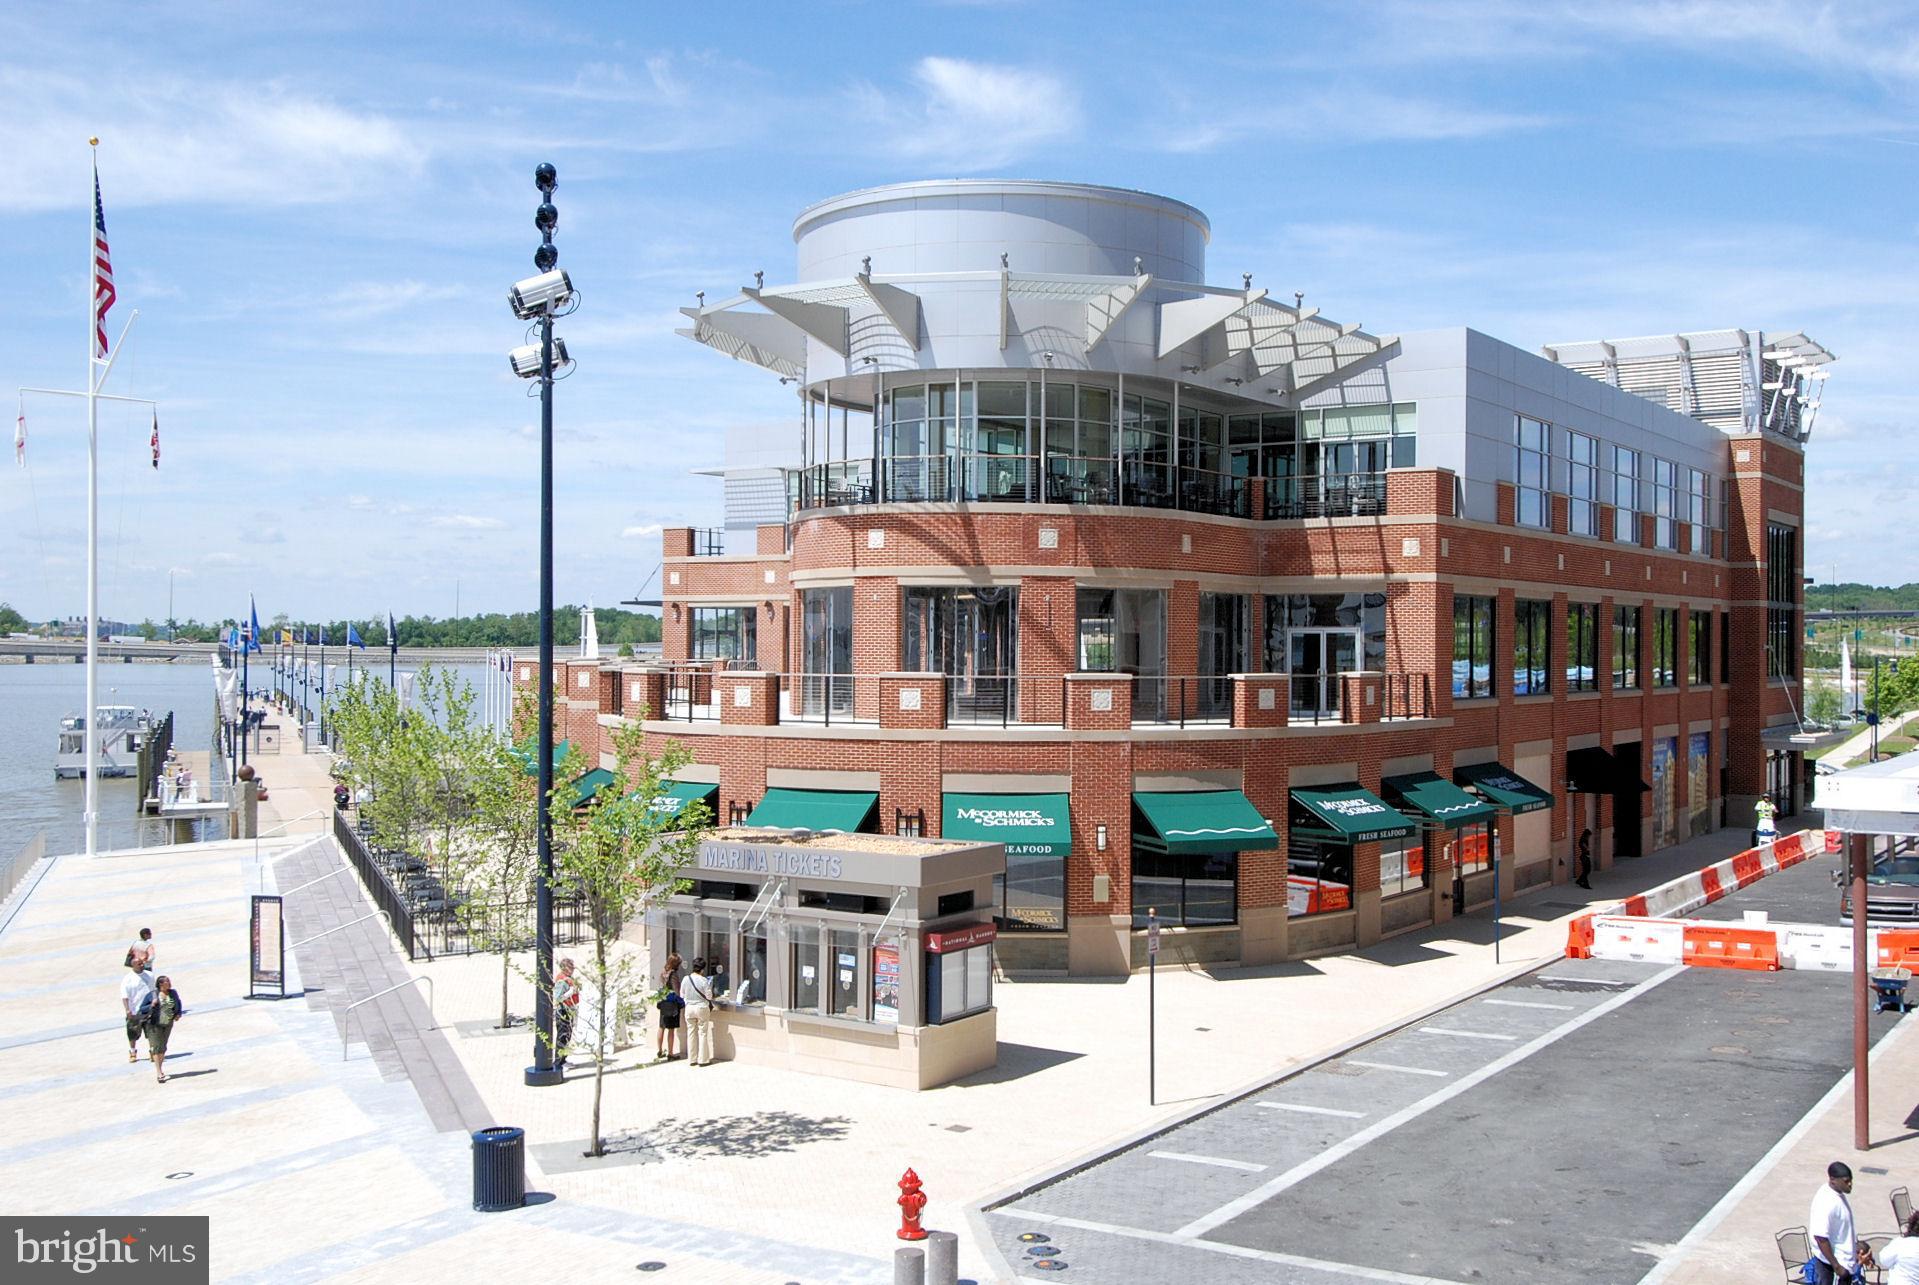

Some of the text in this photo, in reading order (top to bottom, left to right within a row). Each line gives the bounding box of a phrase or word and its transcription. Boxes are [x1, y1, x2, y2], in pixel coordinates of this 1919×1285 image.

[1358, 828, 1407, 841] FRESH SEAFOOD
[704, 846, 842, 878] MARINA TICKETS
